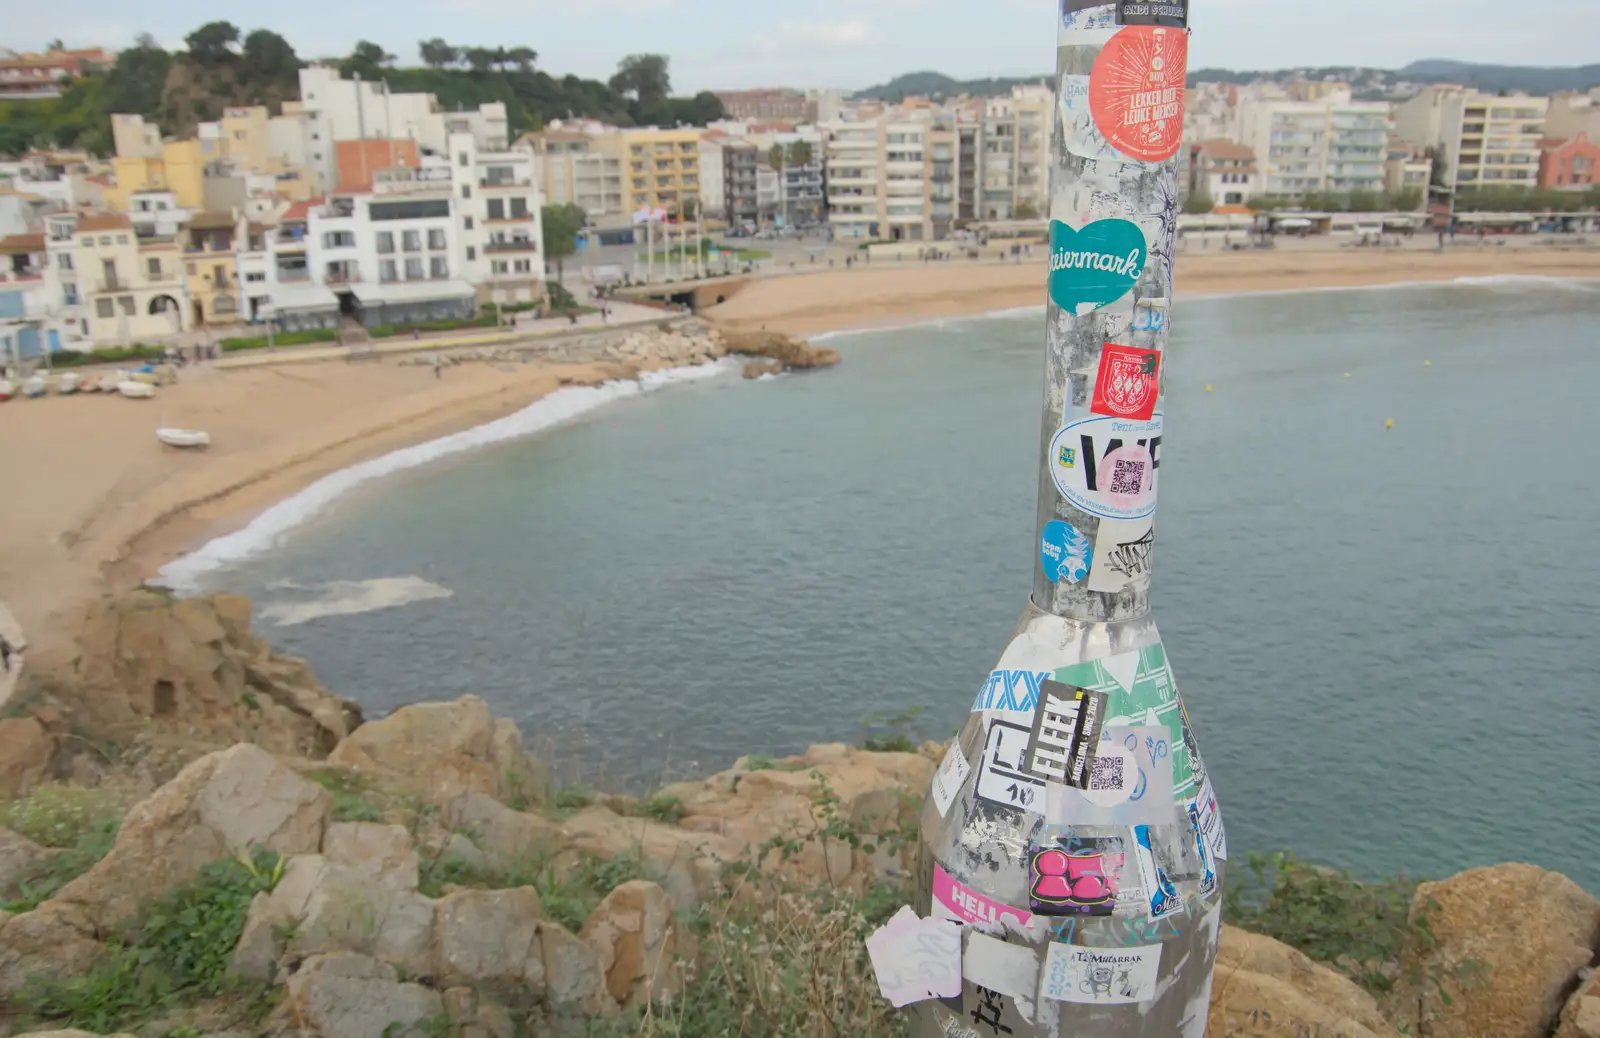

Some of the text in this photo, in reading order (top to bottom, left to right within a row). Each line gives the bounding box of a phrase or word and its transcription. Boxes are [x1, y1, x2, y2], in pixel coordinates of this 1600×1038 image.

[1130, 90, 1162, 110] LEKKER
[1124, 107, 1152, 126] LEUKE
[1072, 697, 1099, 781] BARCELONA SINCE 2020
